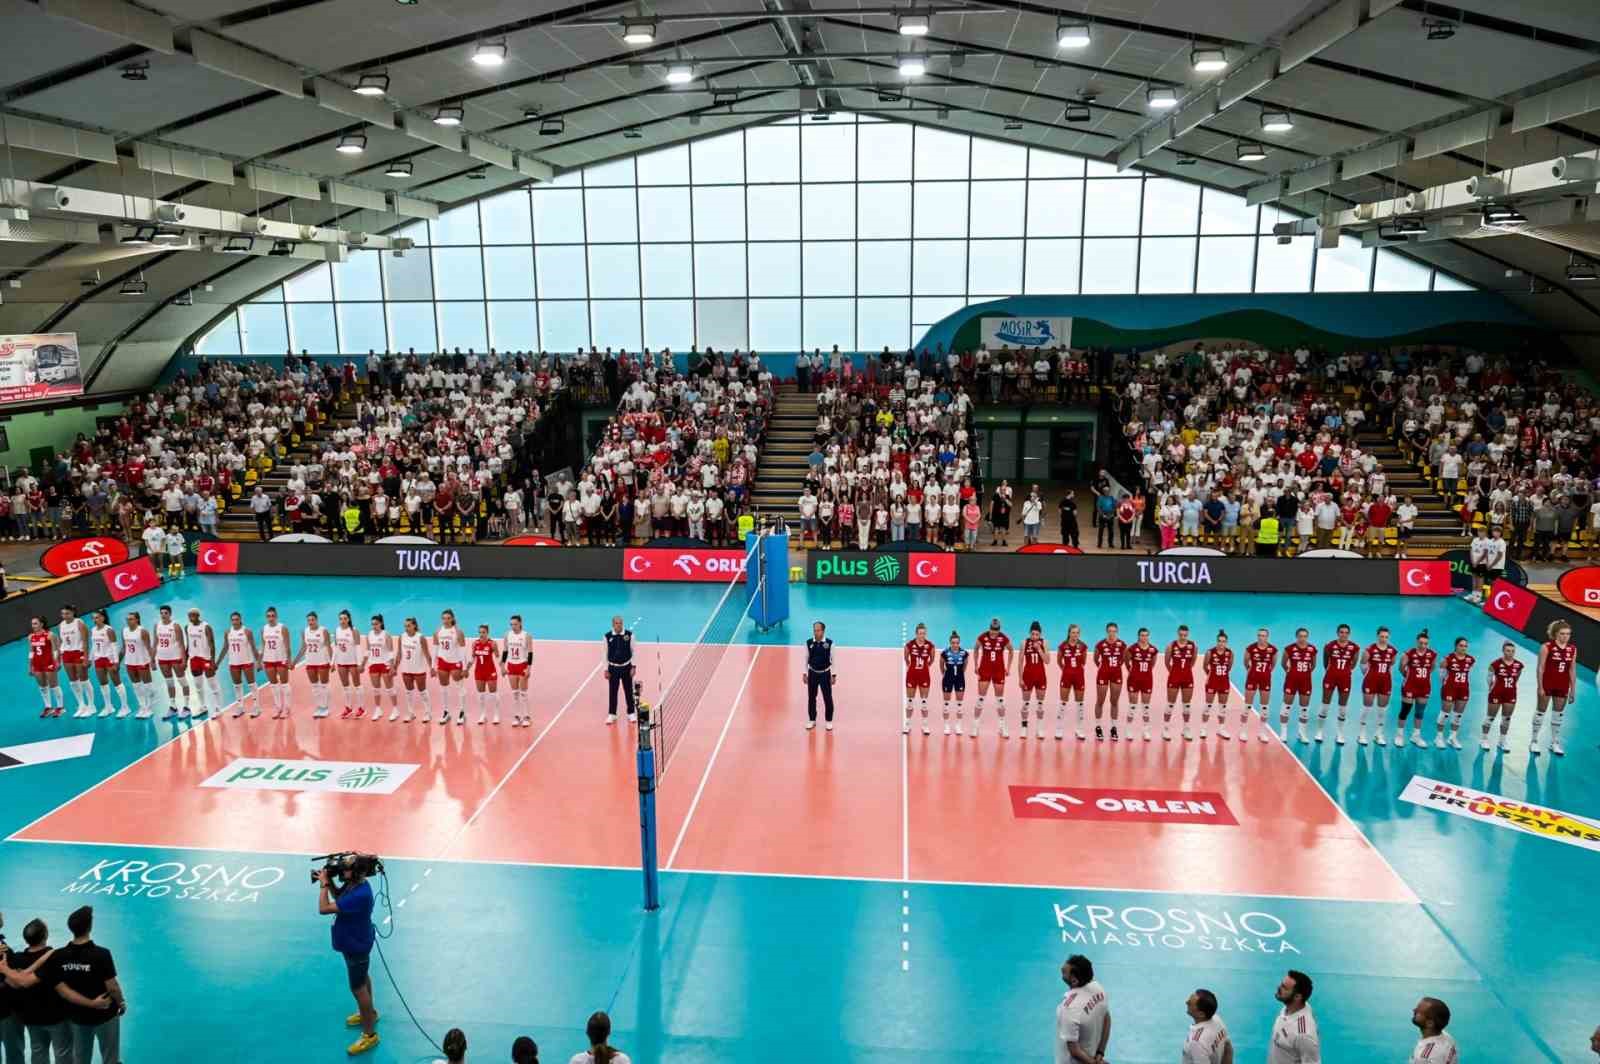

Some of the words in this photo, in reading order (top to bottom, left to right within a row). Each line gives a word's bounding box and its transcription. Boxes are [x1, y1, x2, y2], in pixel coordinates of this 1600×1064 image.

[1000, 320, 1032, 336] MOSiR
[70, 556, 108, 570] ORLEN
[396, 550, 461, 571] TURCJA
[705, 558, 747, 571] ORLE
[816, 555, 868, 579] plus
[1137, 561, 1212, 584] TURCJA
[230, 643, 241, 653] 11
[268, 640, 277, 650] 12
[307, 643, 319, 653] 22
[1031, 653, 1039, 665] 11
[1109, 656, 1118, 667] 15
[1336, 659, 1346, 670] 17
[1255, 662, 1267, 672] 27
[1415, 667, 1427, 678] 30
[1504, 677, 1514, 688] 12
[225, 763, 332, 783] plus
[1095, 798, 1217, 815] ORLEN
[1433, 784, 1567, 821] BLACHY
[78, 858, 286, 889] KROSNO
[61, 881, 171, 898] MIASTO
[176, 887, 259, 903] SZKŁA
[1053, 903, 1287, 937] KROSNO
[1062, 930, 1185, 948] MIASTO
[1200, 936, 1301, 954] SZKŁA
